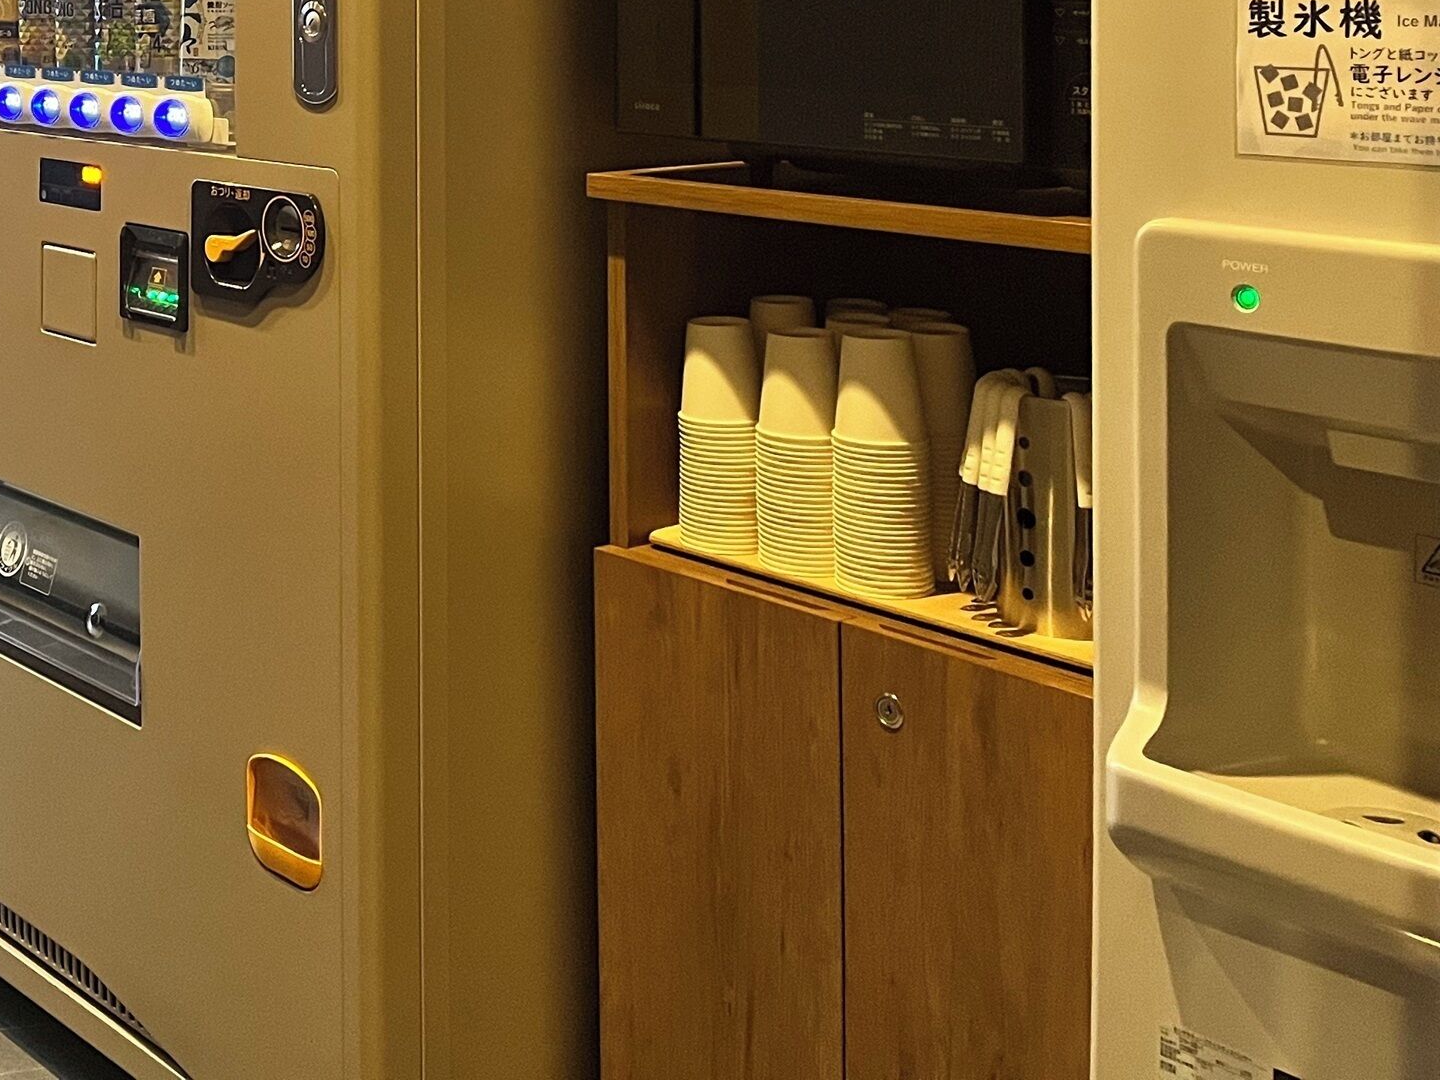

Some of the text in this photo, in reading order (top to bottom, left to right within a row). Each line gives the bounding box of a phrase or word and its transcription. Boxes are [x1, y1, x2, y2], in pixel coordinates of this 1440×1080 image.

[1397, 14, 1440, 28] Ice M
[1349, 47, 1439, 62] トングと紙コッ
[1350, 87, 1434, 102] にございます
[1351, 100, 1434, 116] Tongs and Paper
[1350, 113, 1379, 122] under
[1382, 113, 1398, 123] the
[1221, 259, 1270, 274] POWER
